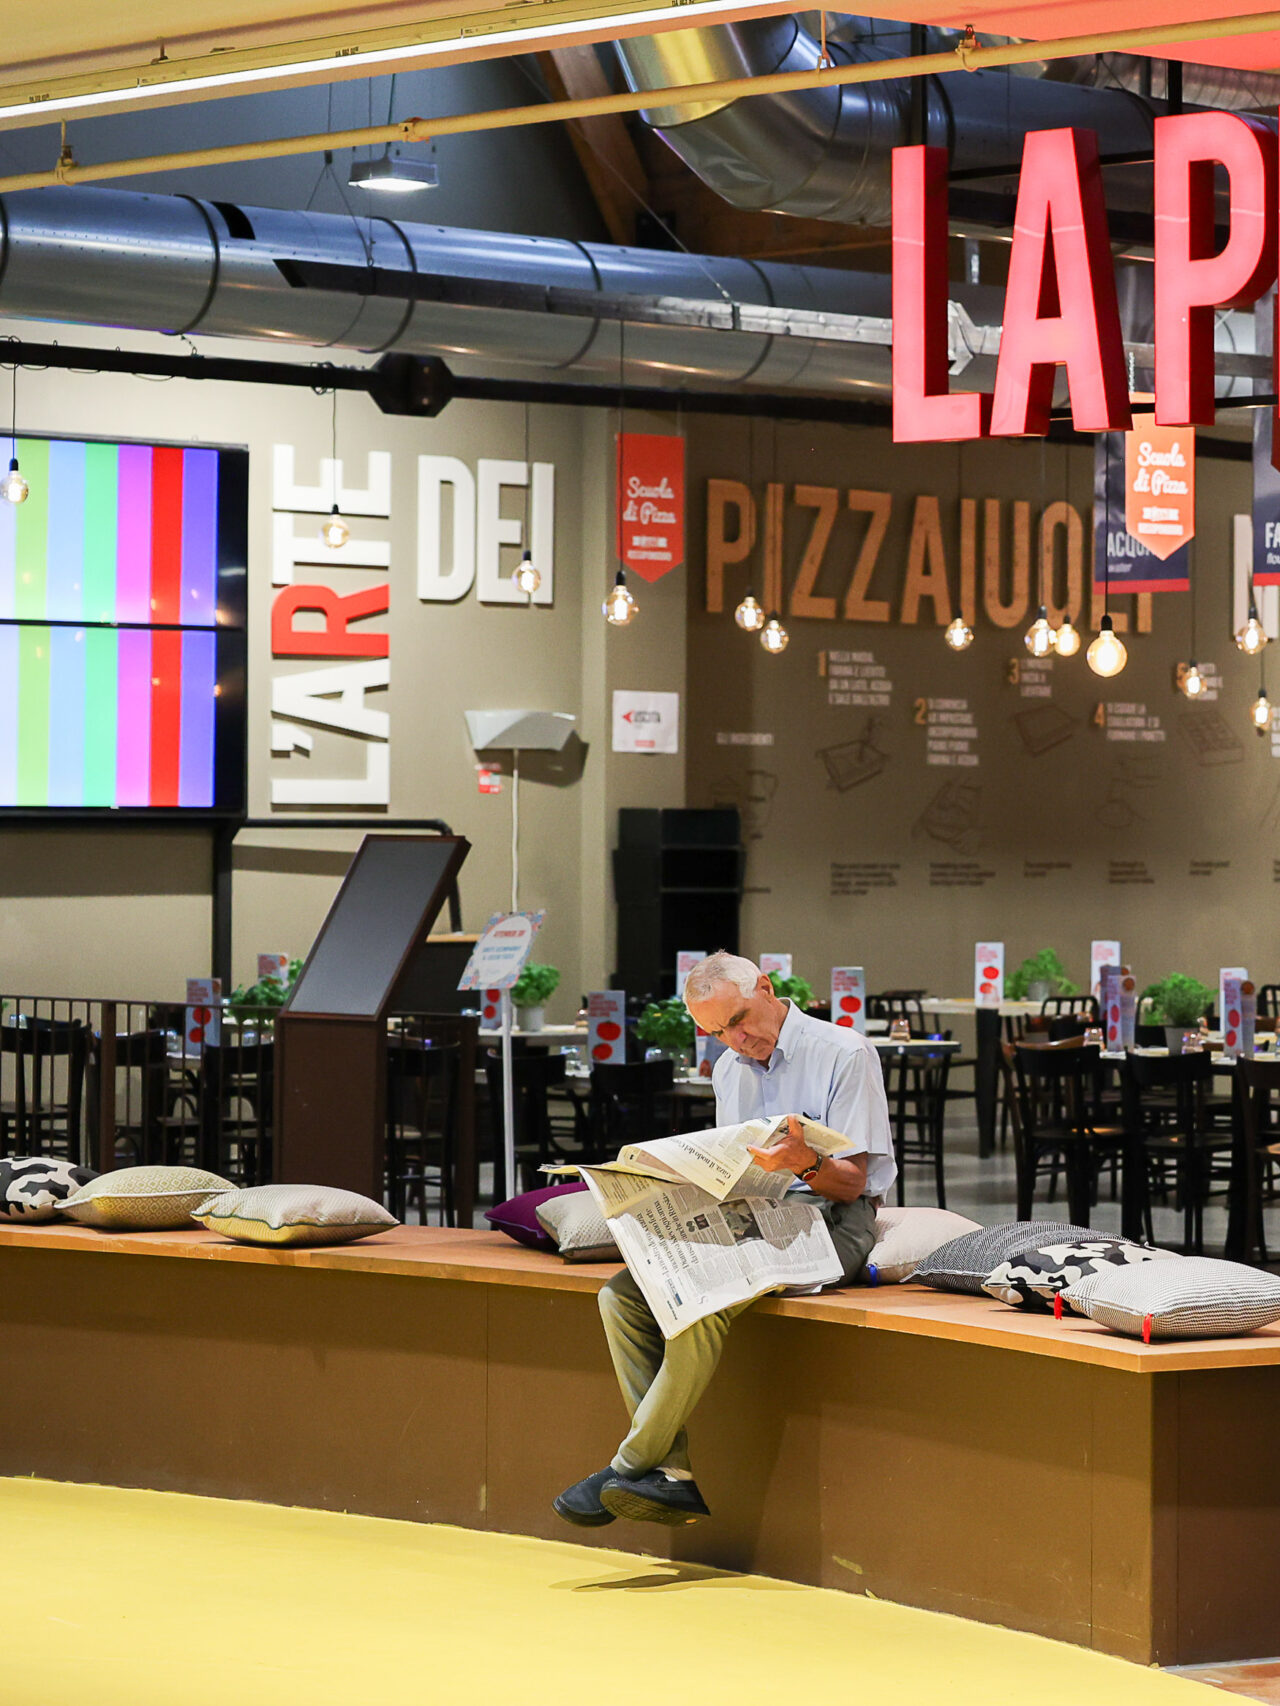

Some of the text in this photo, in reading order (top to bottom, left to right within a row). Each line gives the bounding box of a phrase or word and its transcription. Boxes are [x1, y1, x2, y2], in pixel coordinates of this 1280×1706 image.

[892, 126, 1131, 442] LA
[1137, 442, 1187, 467] Scuola
[627, 476, 675, 499] Scuola
[1133, 467, 1189, 496] di Pizza
[623, 500, 677, 525] di Pizza
[417, 454, 555, 605] DEI
[271, 444, 391, 804] L'ARTE
[1008, 657, 1020, 685] 3
[915, 698, 927, 725] 2
[1094, 702, 1106, 728] 4
